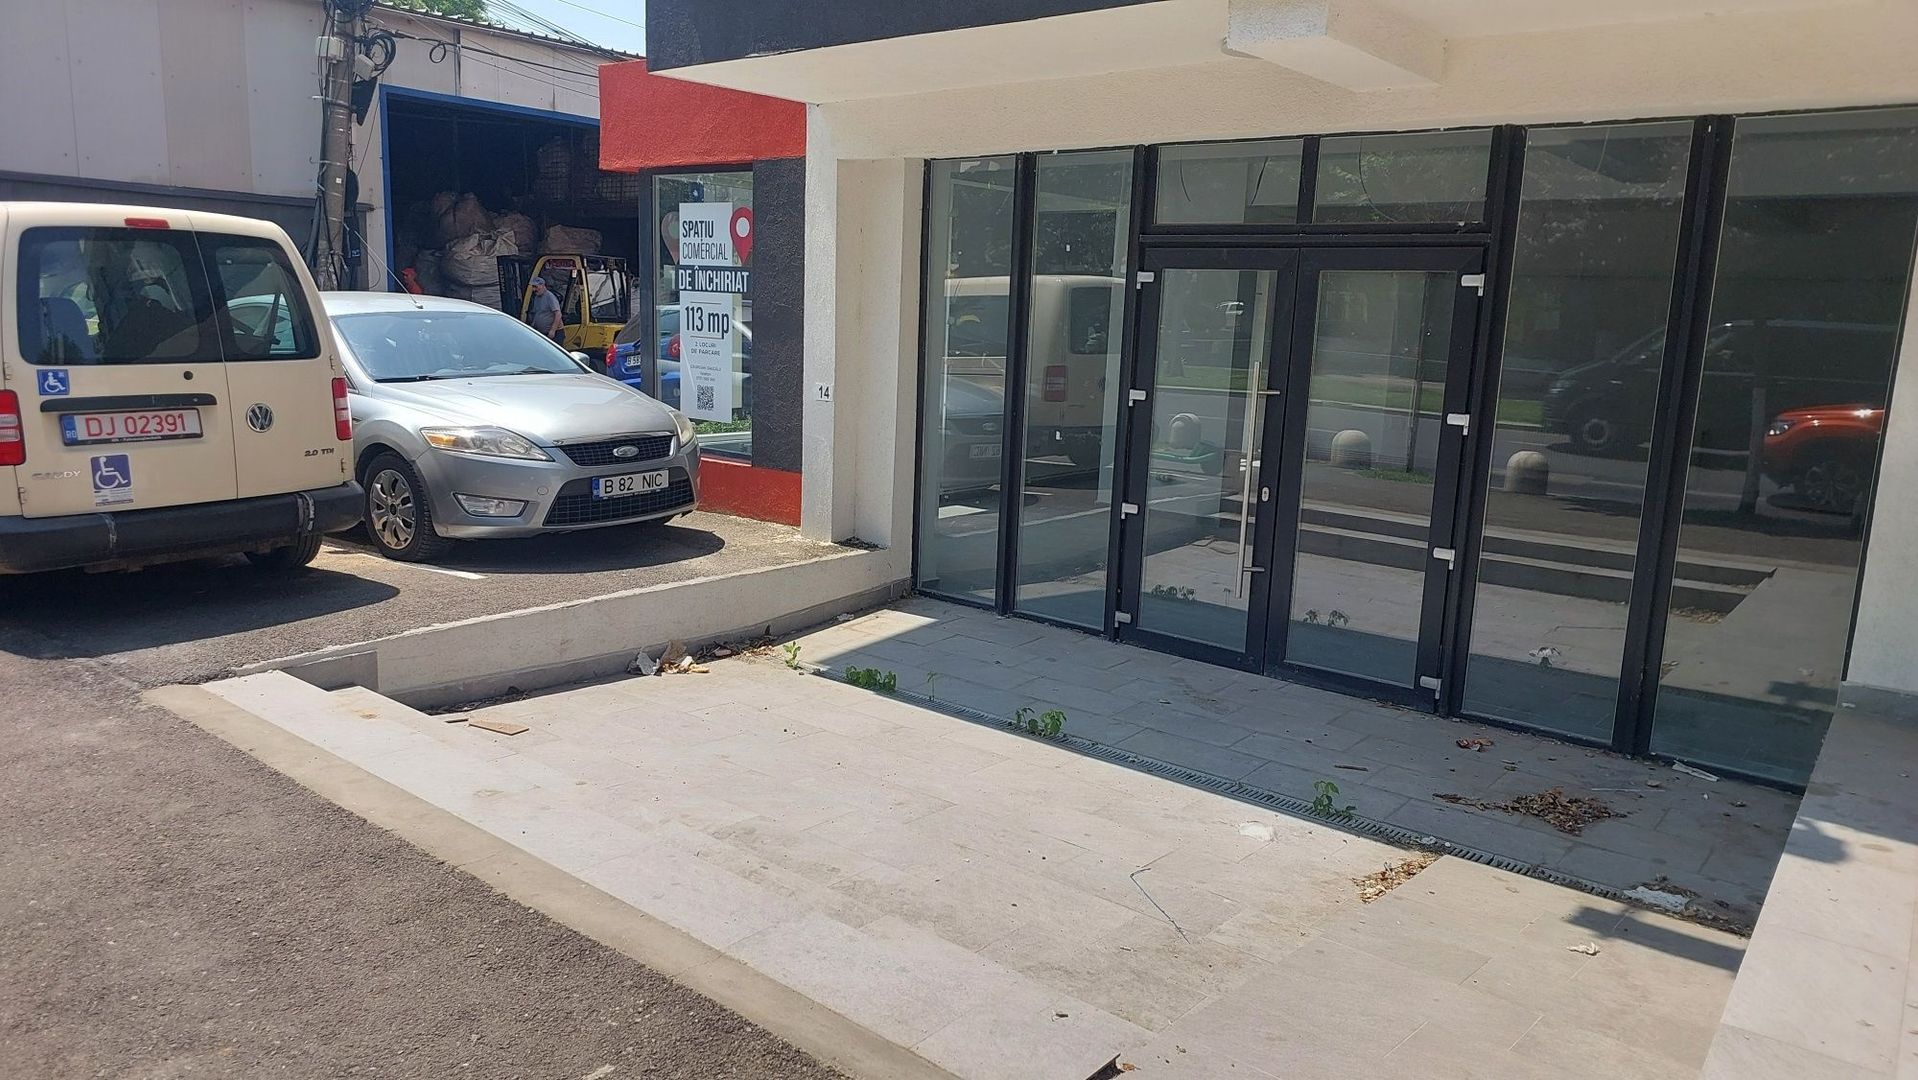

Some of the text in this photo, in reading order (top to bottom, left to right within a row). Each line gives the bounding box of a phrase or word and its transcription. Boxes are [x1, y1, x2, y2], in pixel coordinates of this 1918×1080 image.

[682, 220, 714, 242] SPAȚIU
[682, 242, 729, 261] COMERCIAL
[679, 266, 749, 292] DE ÎNCHIRIAT
[685, 306, 730, 340] 113 mp
[699, 348, 721, 356] PARCARE
[818, 385, 830, 399] 14
[85, 413, 187, 437] DJ 02391
[604, 479, 614, 494] B
[619, 476, 634, 491] 82
[642, 473, 663, 489] NIC
